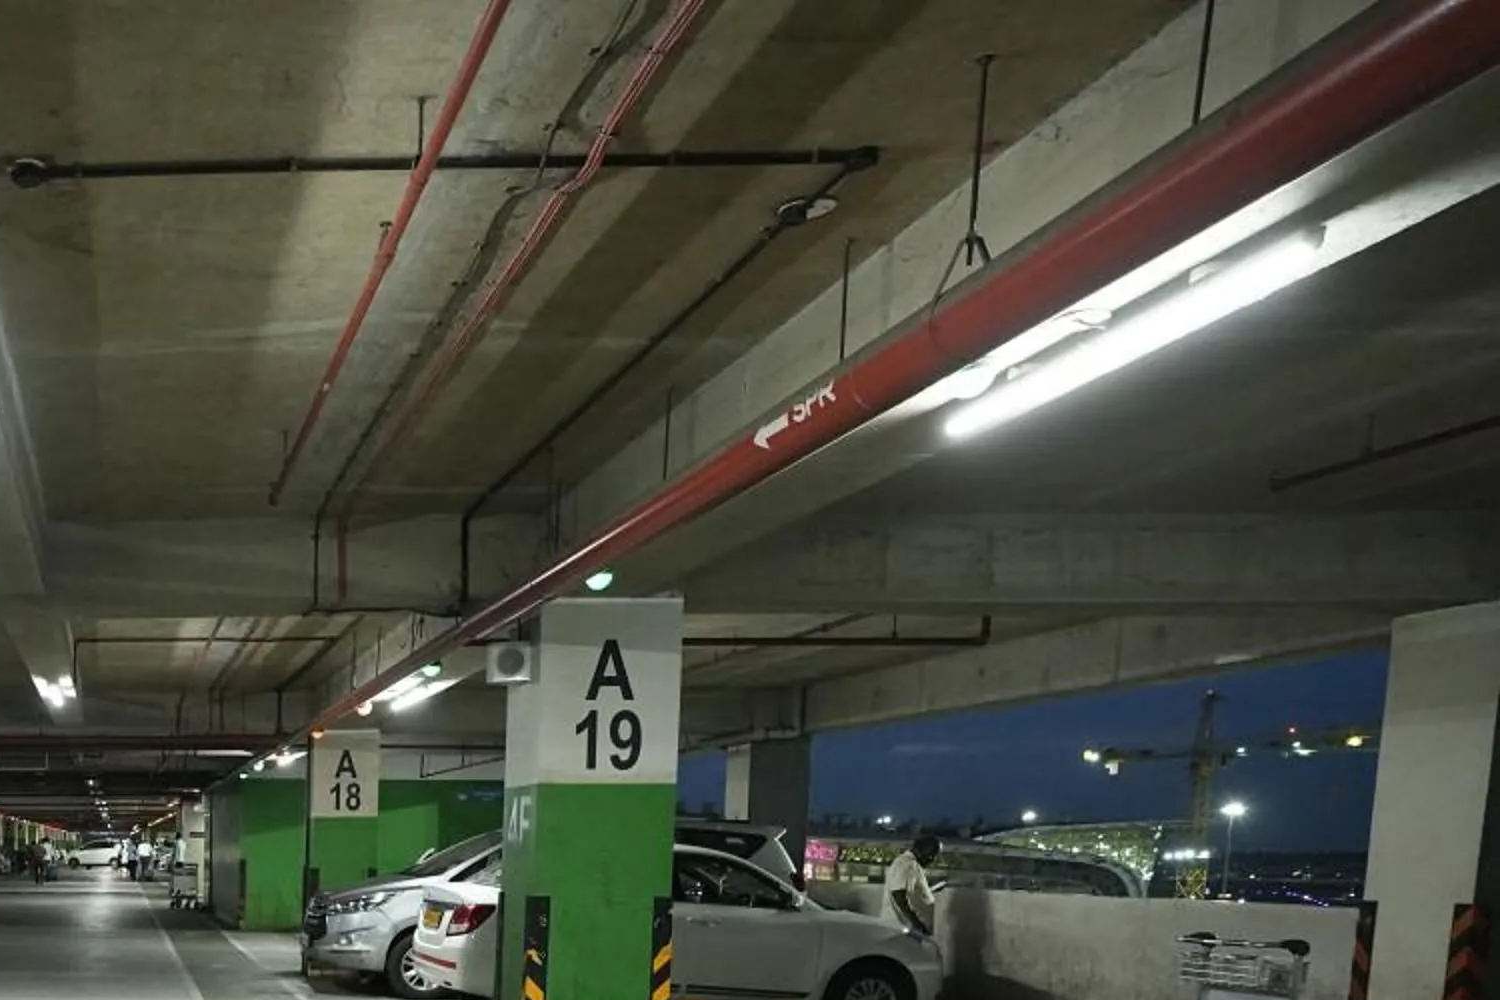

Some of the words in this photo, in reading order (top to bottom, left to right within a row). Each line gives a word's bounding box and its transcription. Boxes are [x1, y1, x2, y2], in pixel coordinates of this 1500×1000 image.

[585, 639, 634, 700] A
[575, 709, 642, 770] 19
[336, 749, 356, 778] A
[330, 782, 361, 811] 18
